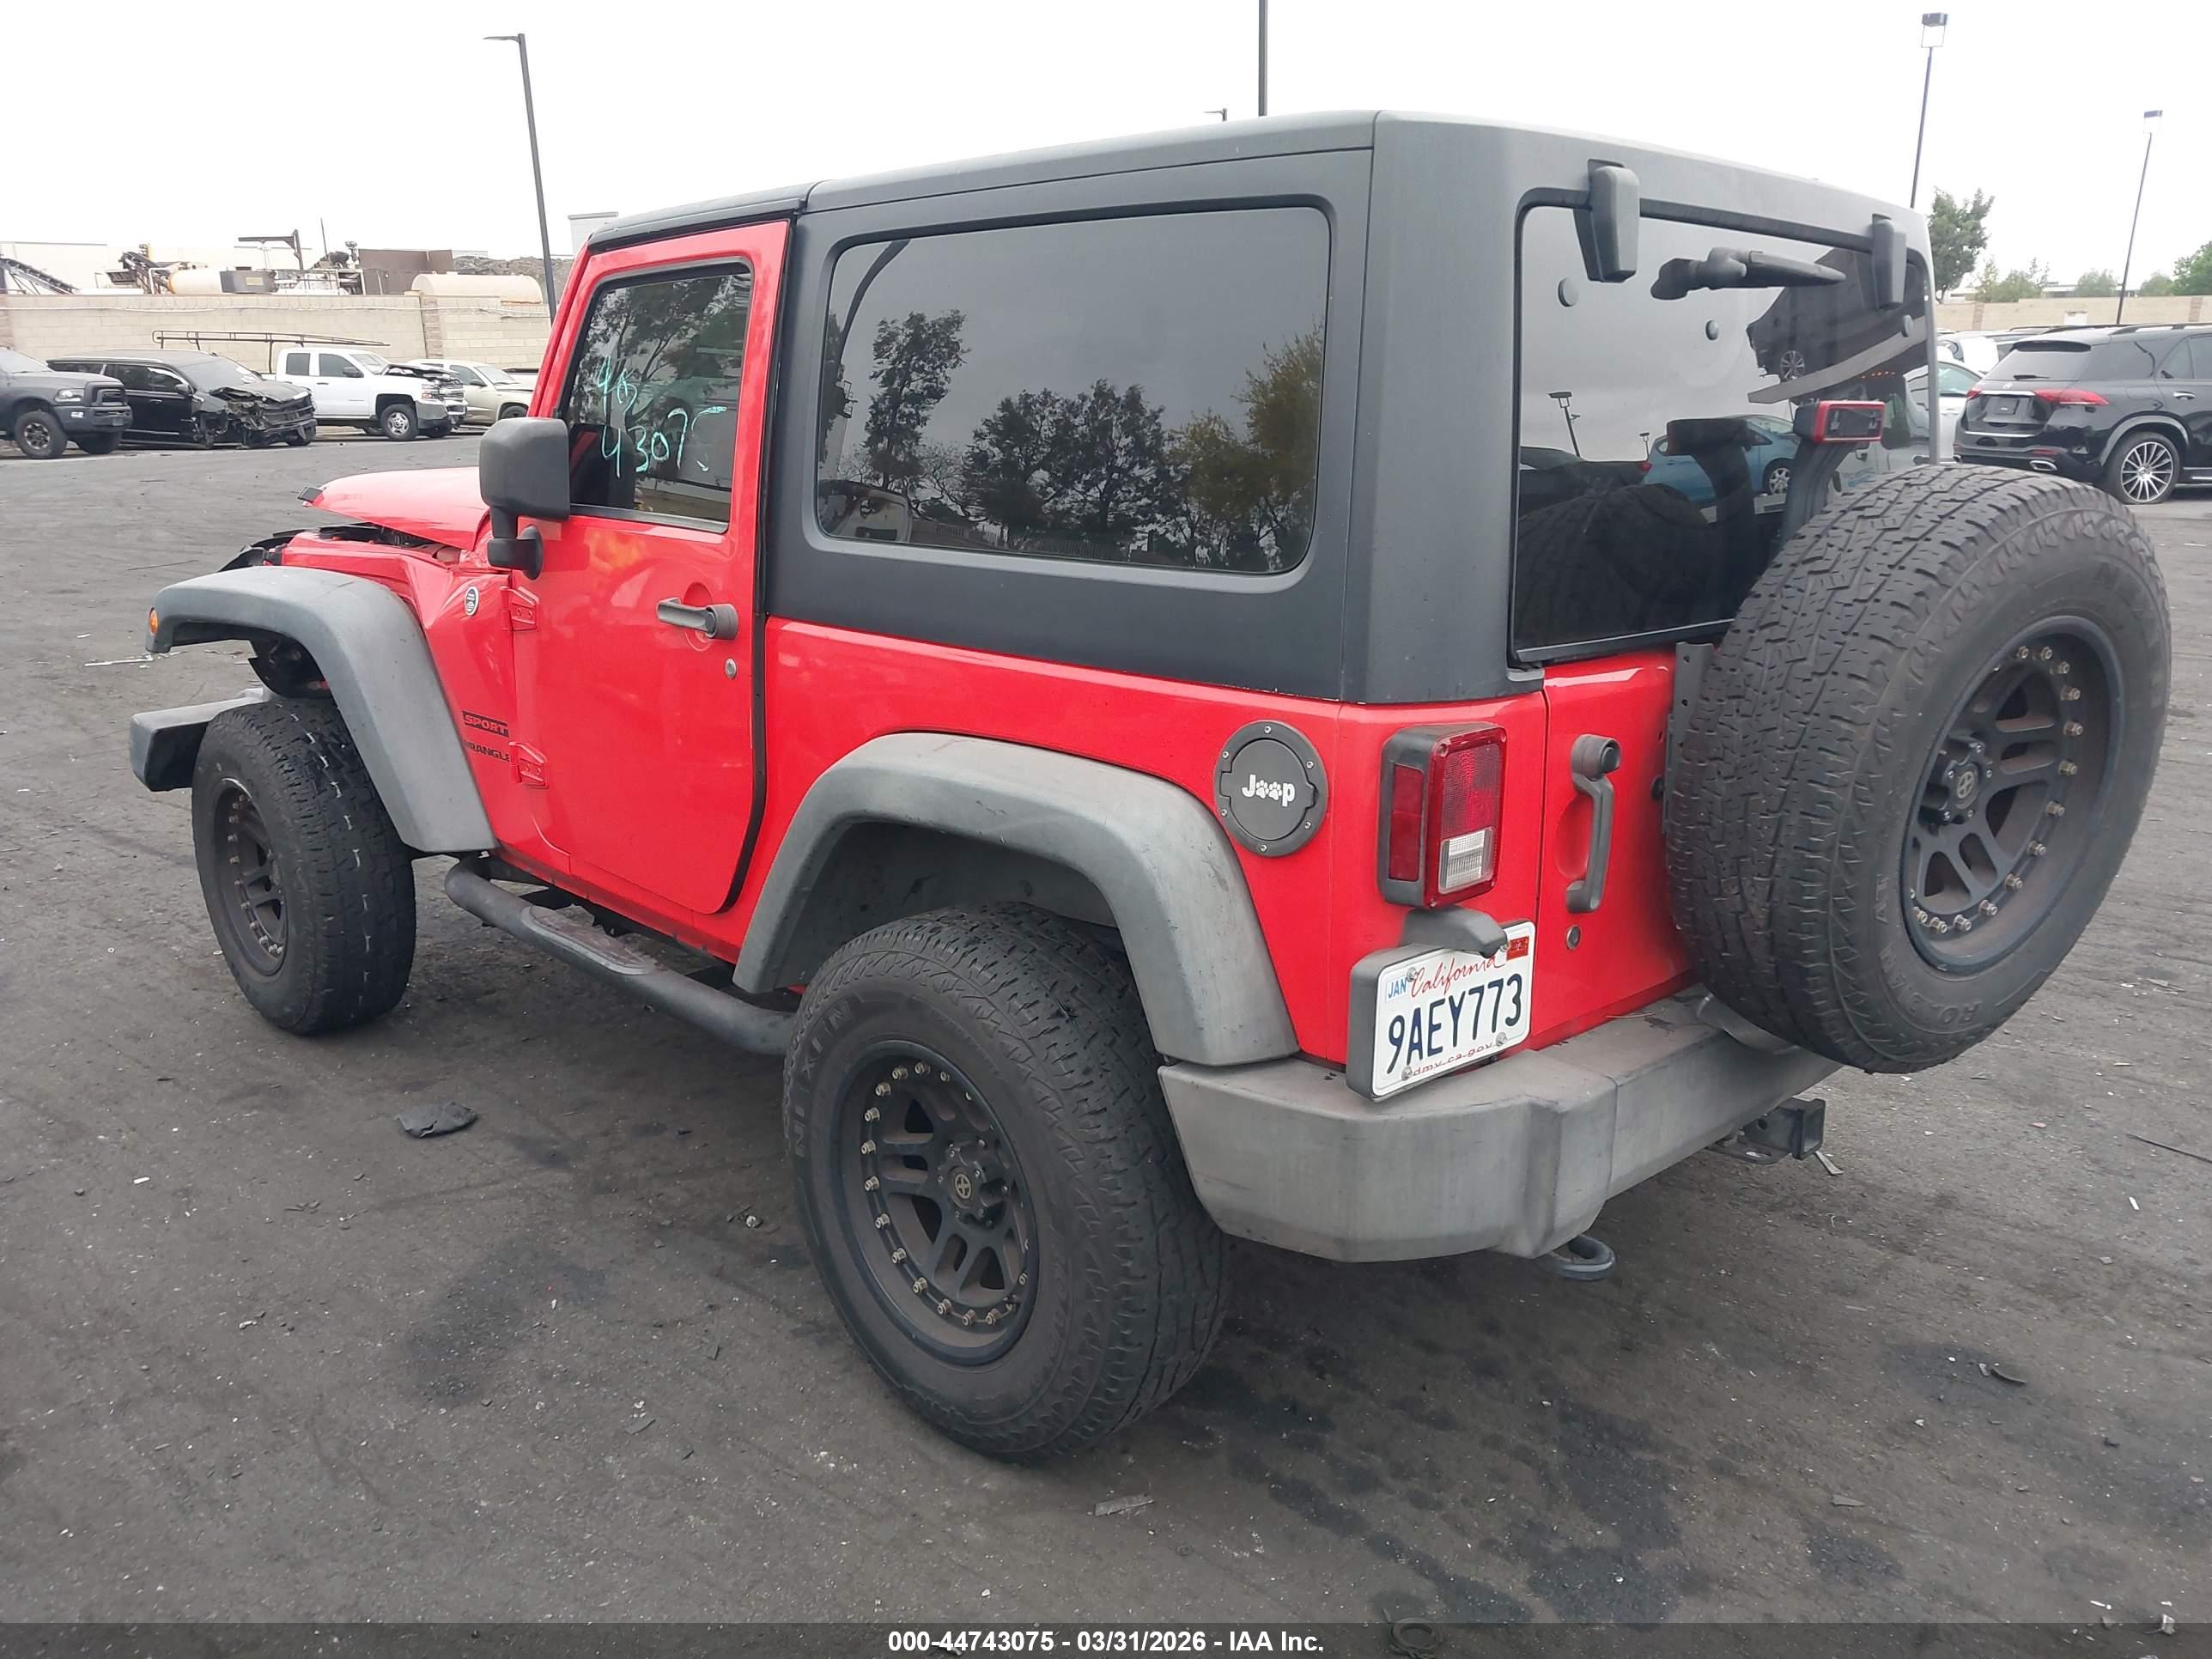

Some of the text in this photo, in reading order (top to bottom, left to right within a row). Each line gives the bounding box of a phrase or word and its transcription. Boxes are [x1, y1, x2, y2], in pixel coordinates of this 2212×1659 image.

[465, 714, 505, 735] SPORT
[1388, 977, 1407, 999] JAN
[1411, 955, 1505, 998] California
[1387, 974, 1522, 1074] 9AEY773
[1413, 1042, 1493, 1077] dmv.ca.gov
